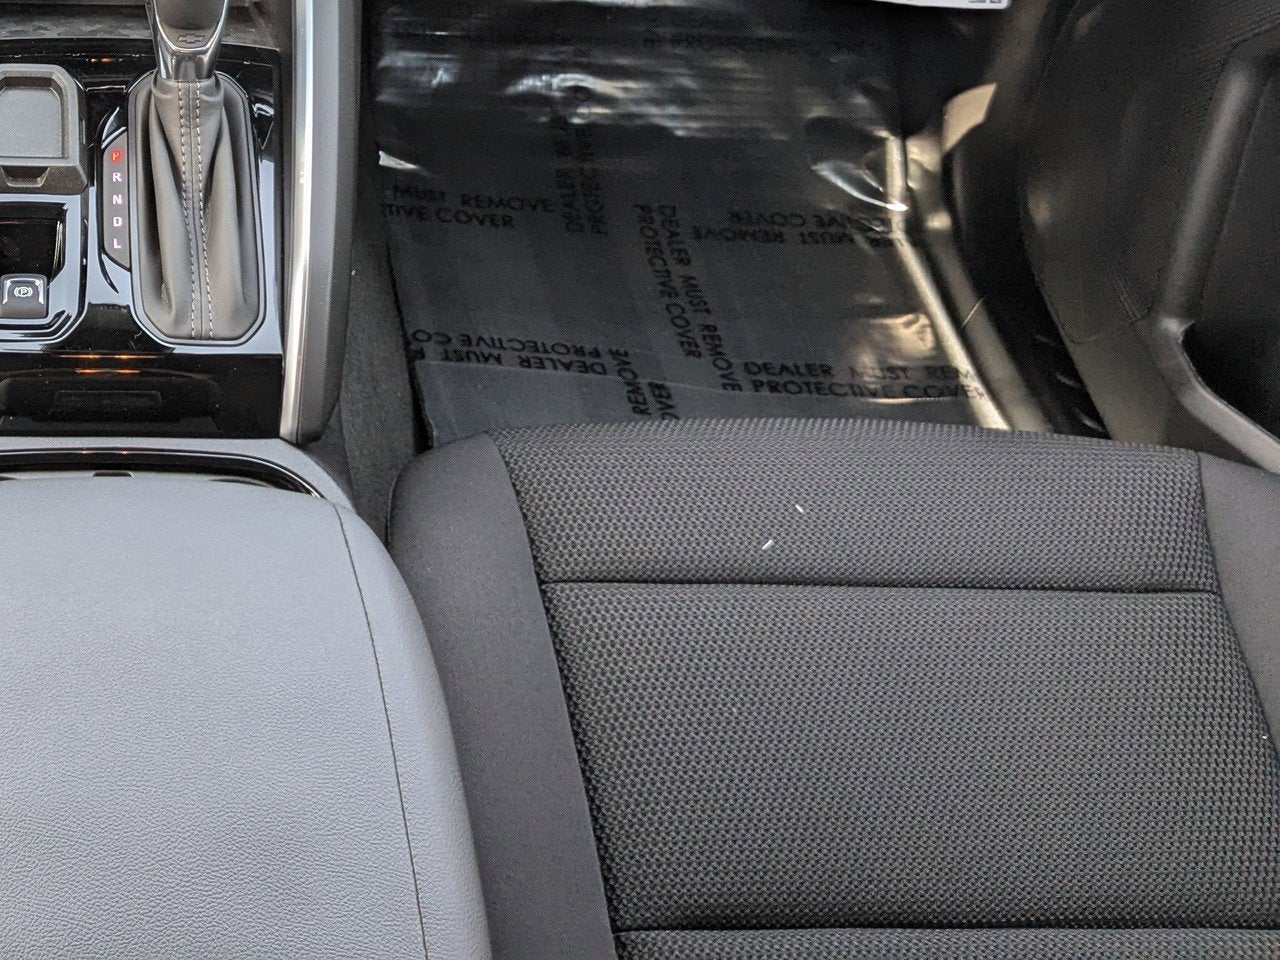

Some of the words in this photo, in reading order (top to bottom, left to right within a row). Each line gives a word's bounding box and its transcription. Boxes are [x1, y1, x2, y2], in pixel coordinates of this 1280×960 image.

[111, 150, 121, 161] P
[112, 172, 122, 182] R
[112, 194, 122, 205] N
[460, 192, 555, 214] REMOVE
[113, 217, 122, 227] D
[436, 207, 516, 230] COVER
[113, 238, 122, 249] L
[633, 203, 680, 299] PROTECTIVE
[664, 302, 702, 359] COVER
[657, 204, 692, 266] DEALER
[680, 275, 712, 315] MUST
[697, 322, 744, 392] REMOVE
[441, 346, 504, 367] MUST
[457, 332, 603, 360] PROTECTIVE
[517, 354, 608, 376] DEALER
[743, 361, 834, 377] DEALER
[608, 348, 652, 416] REMOVE
